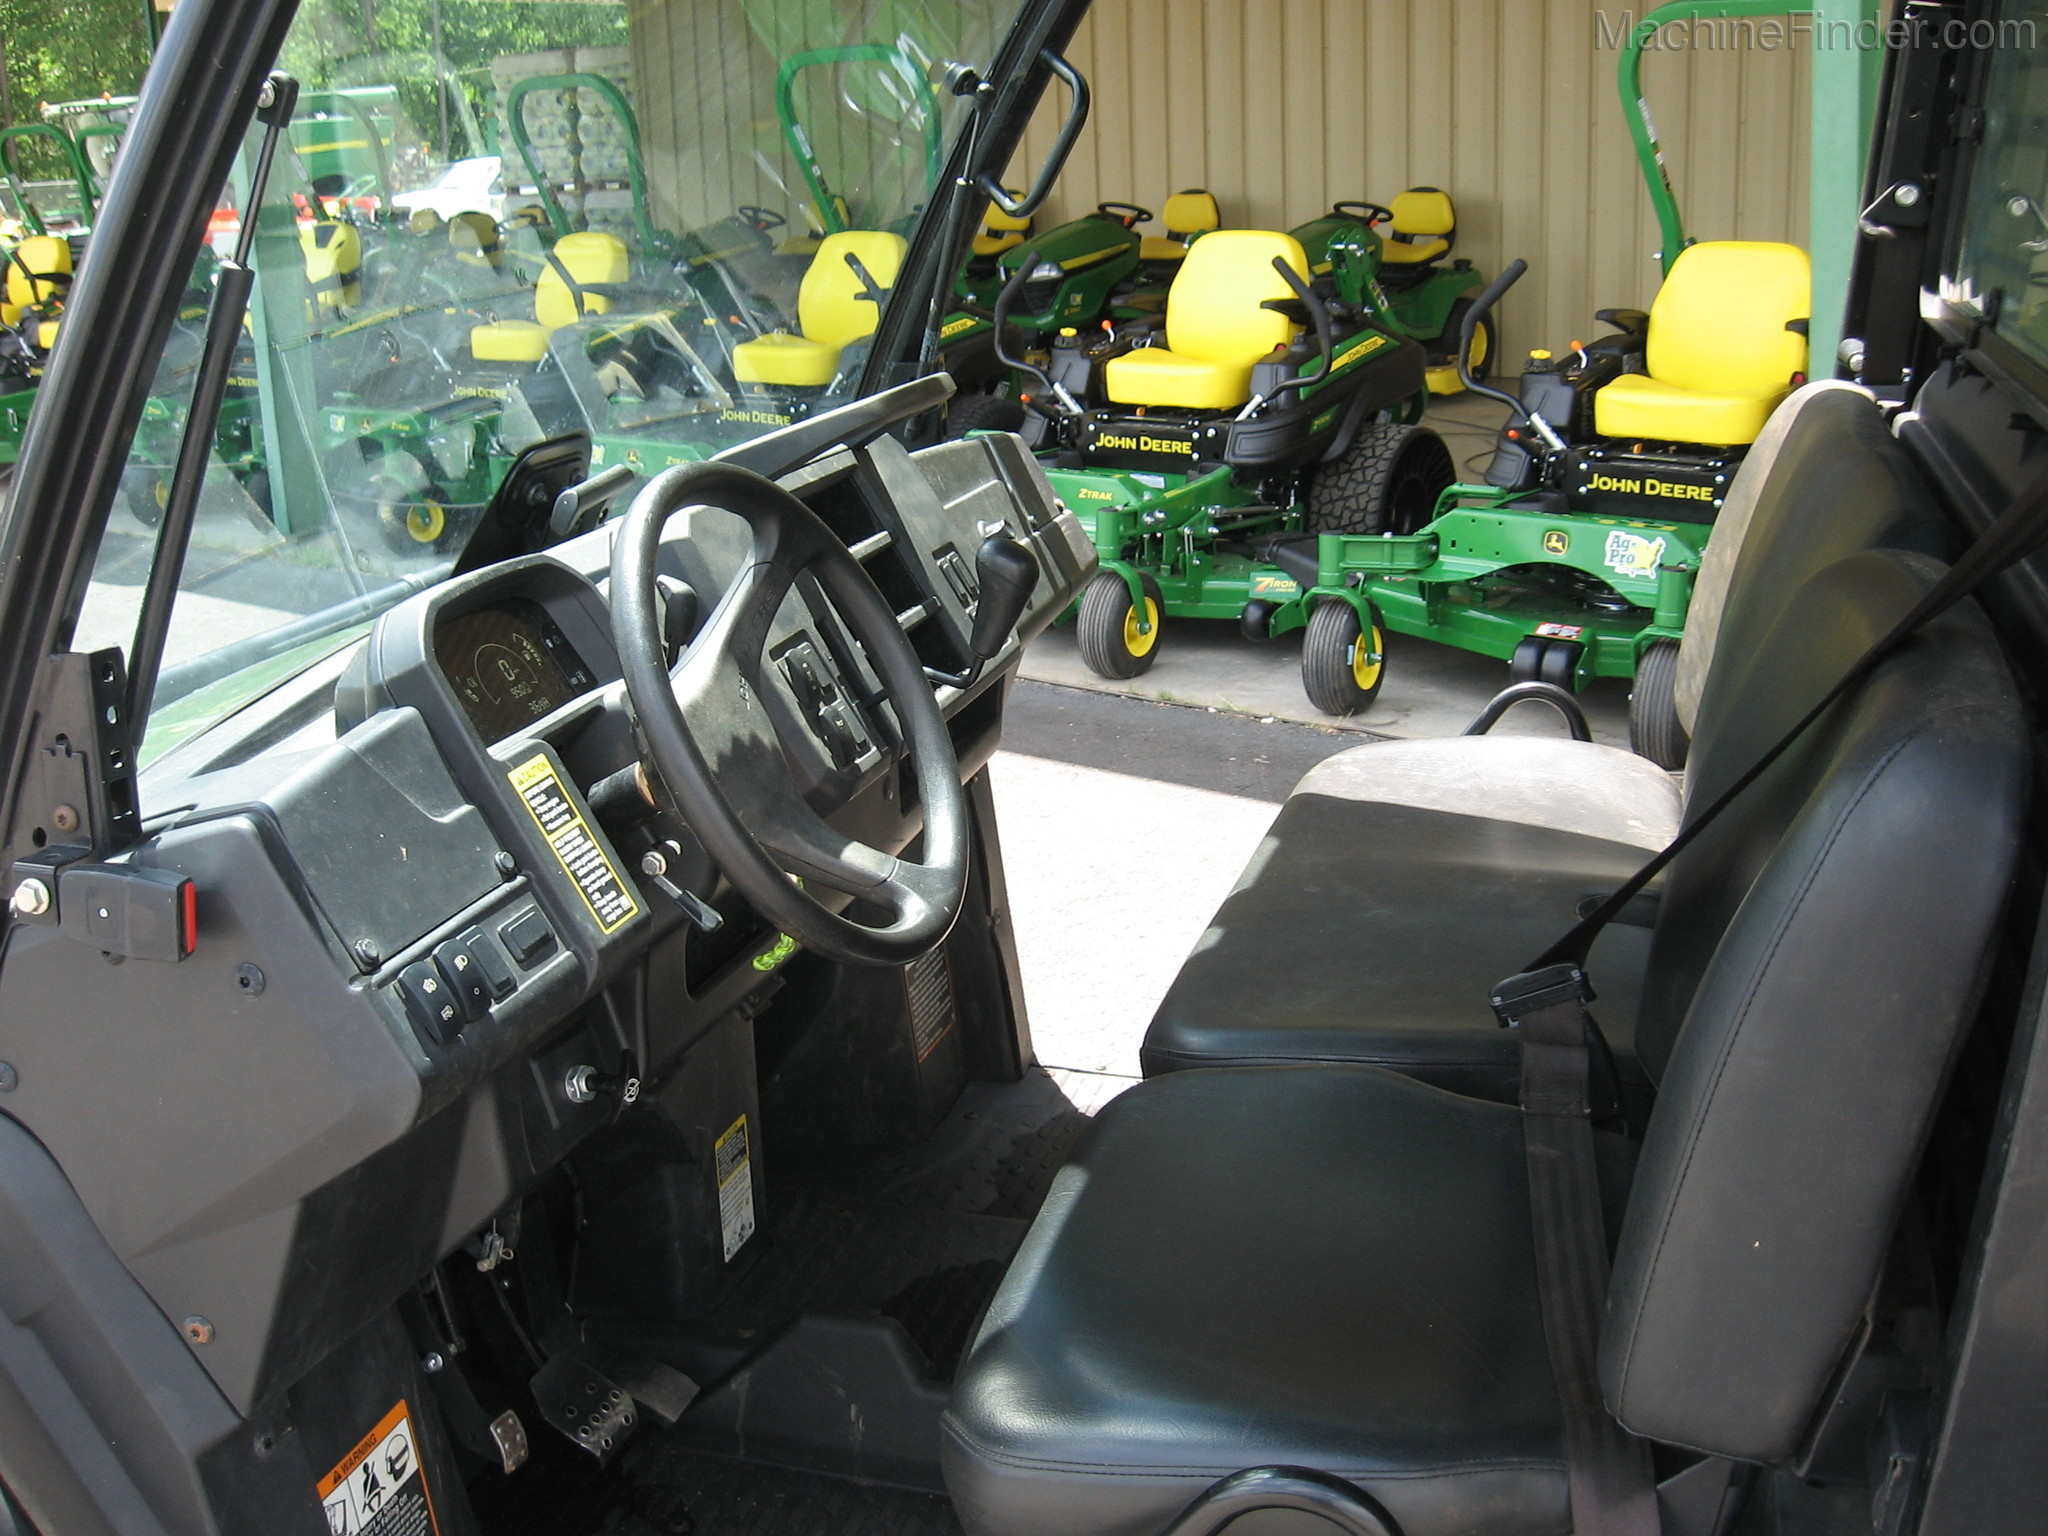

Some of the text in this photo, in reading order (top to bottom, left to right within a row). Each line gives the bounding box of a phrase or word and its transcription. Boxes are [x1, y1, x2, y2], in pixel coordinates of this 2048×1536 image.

[720, 408, 792, 425] JOHN DEERE
[1096, 433, 1192, 454] JOHN DEERE
[1078, 488, 1113, 500] ZTRAK
[1587, 473, 1714, 501] JOHN DEERE
[1609, 535, 1636, 552] Ag-
[1609, 550, 1635, 564] Pro
[341, 1433, 377, 1475] WARNING
